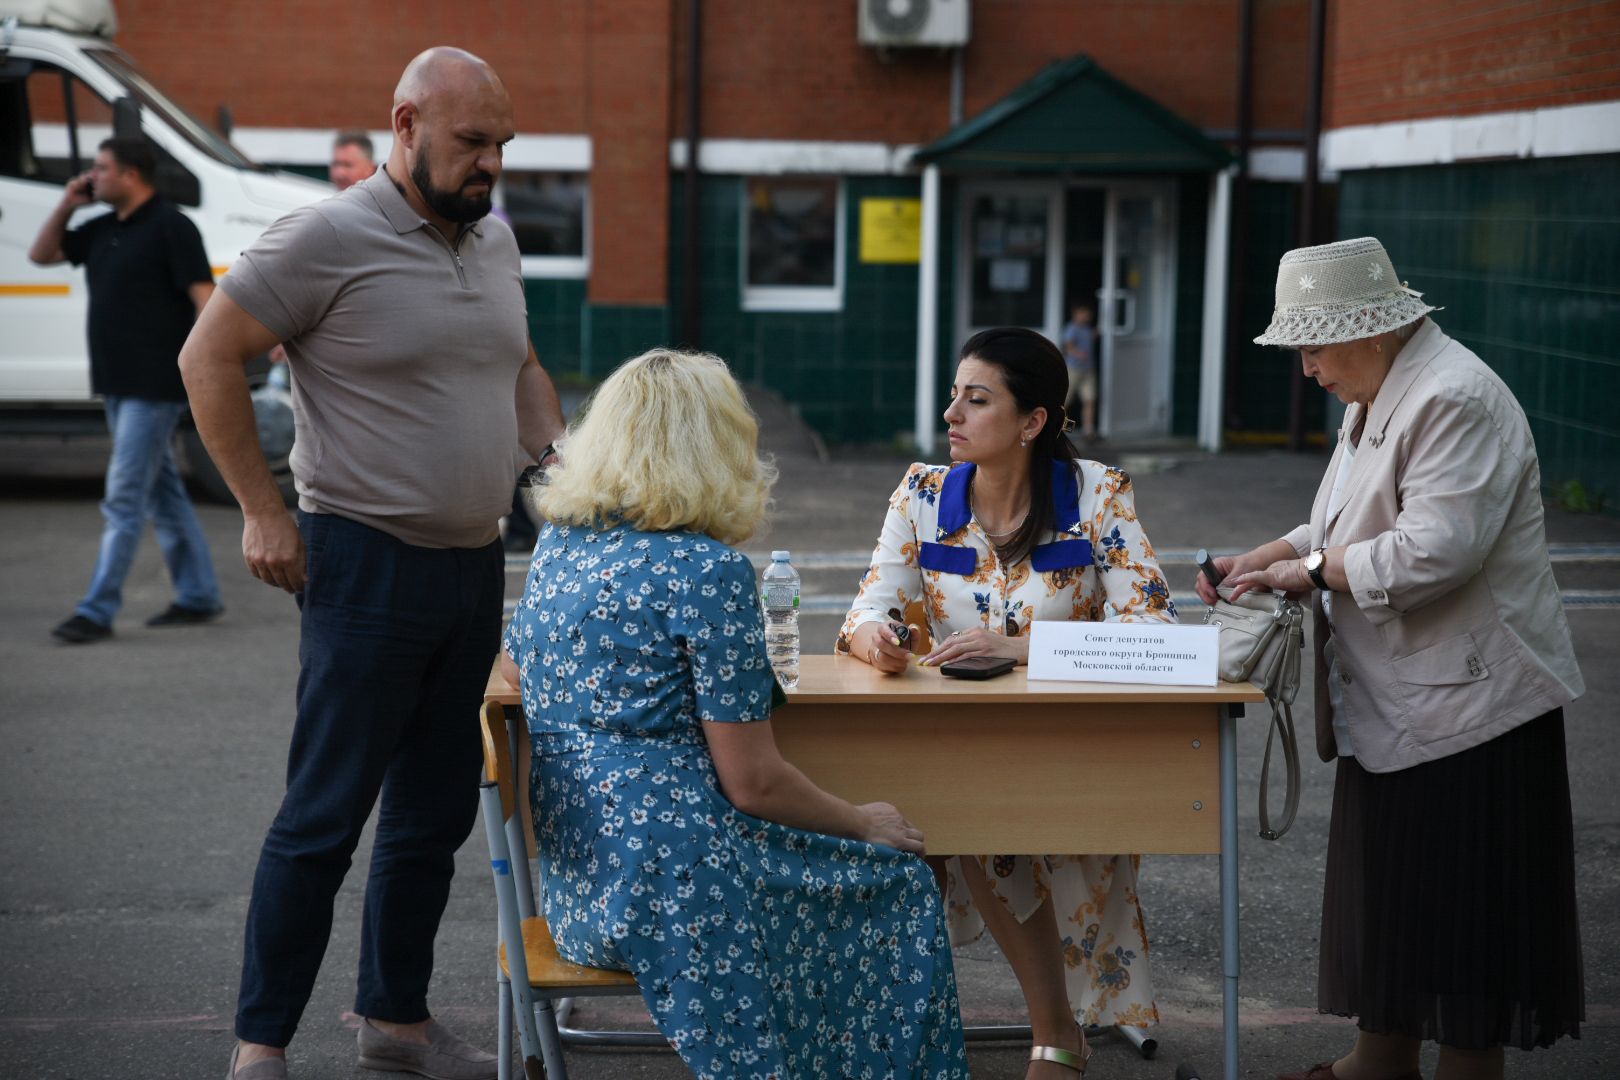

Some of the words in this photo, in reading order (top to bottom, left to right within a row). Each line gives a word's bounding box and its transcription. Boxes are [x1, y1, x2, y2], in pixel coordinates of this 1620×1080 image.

[1084, 633, 1113, 644] Совет
[1115, 636, 1165, 646] депутатов
[1053, 648, 1107, 659] городского
[1109, 650, 1143, 660] округа
[1145, 650, 1197, 661] Бронницы
[1072, 660, 1132, 671] Московской
[1134, 662, 1174, 673] области
